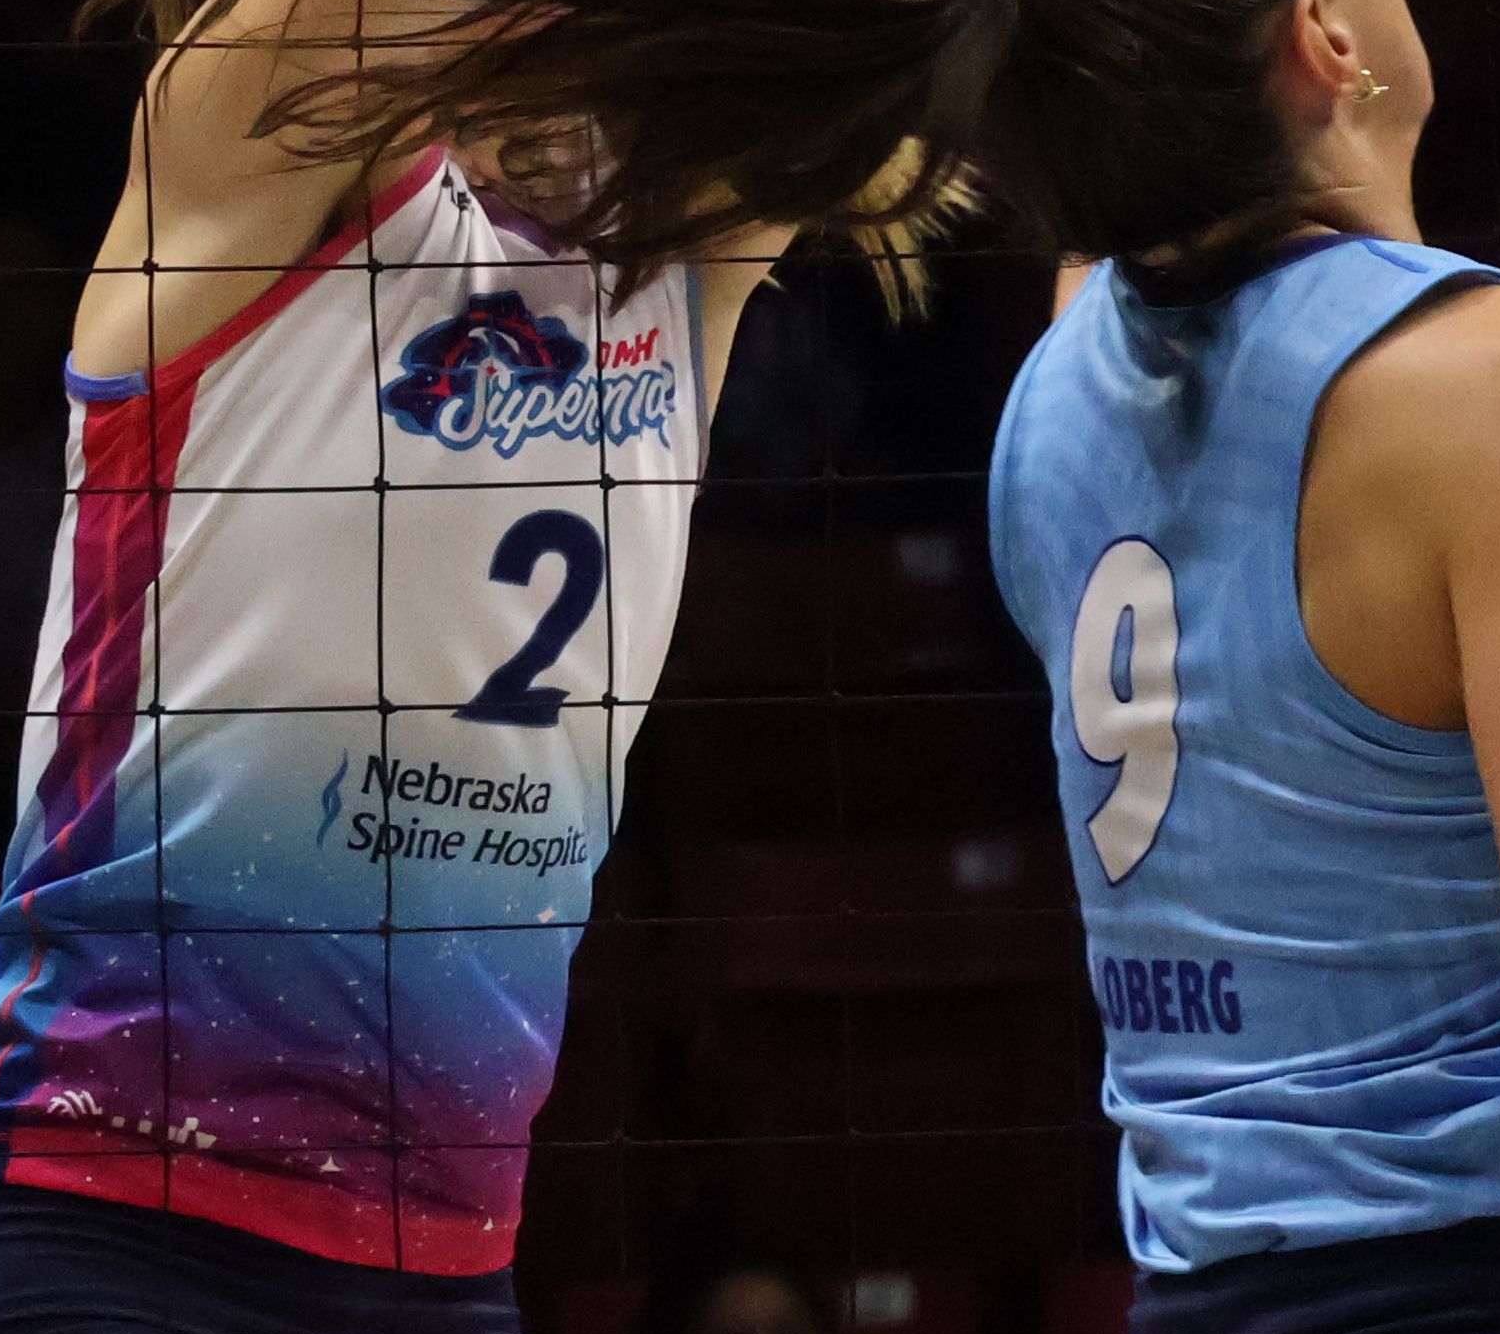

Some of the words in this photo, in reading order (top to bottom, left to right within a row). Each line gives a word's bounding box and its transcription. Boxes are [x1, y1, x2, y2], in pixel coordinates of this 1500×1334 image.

[450, 508, 605, 728] 2
[1071, 534, 1181, 889] 9
[346, 812, 467, 864] Spine
[360, 755, 552, 815] Nebraska
